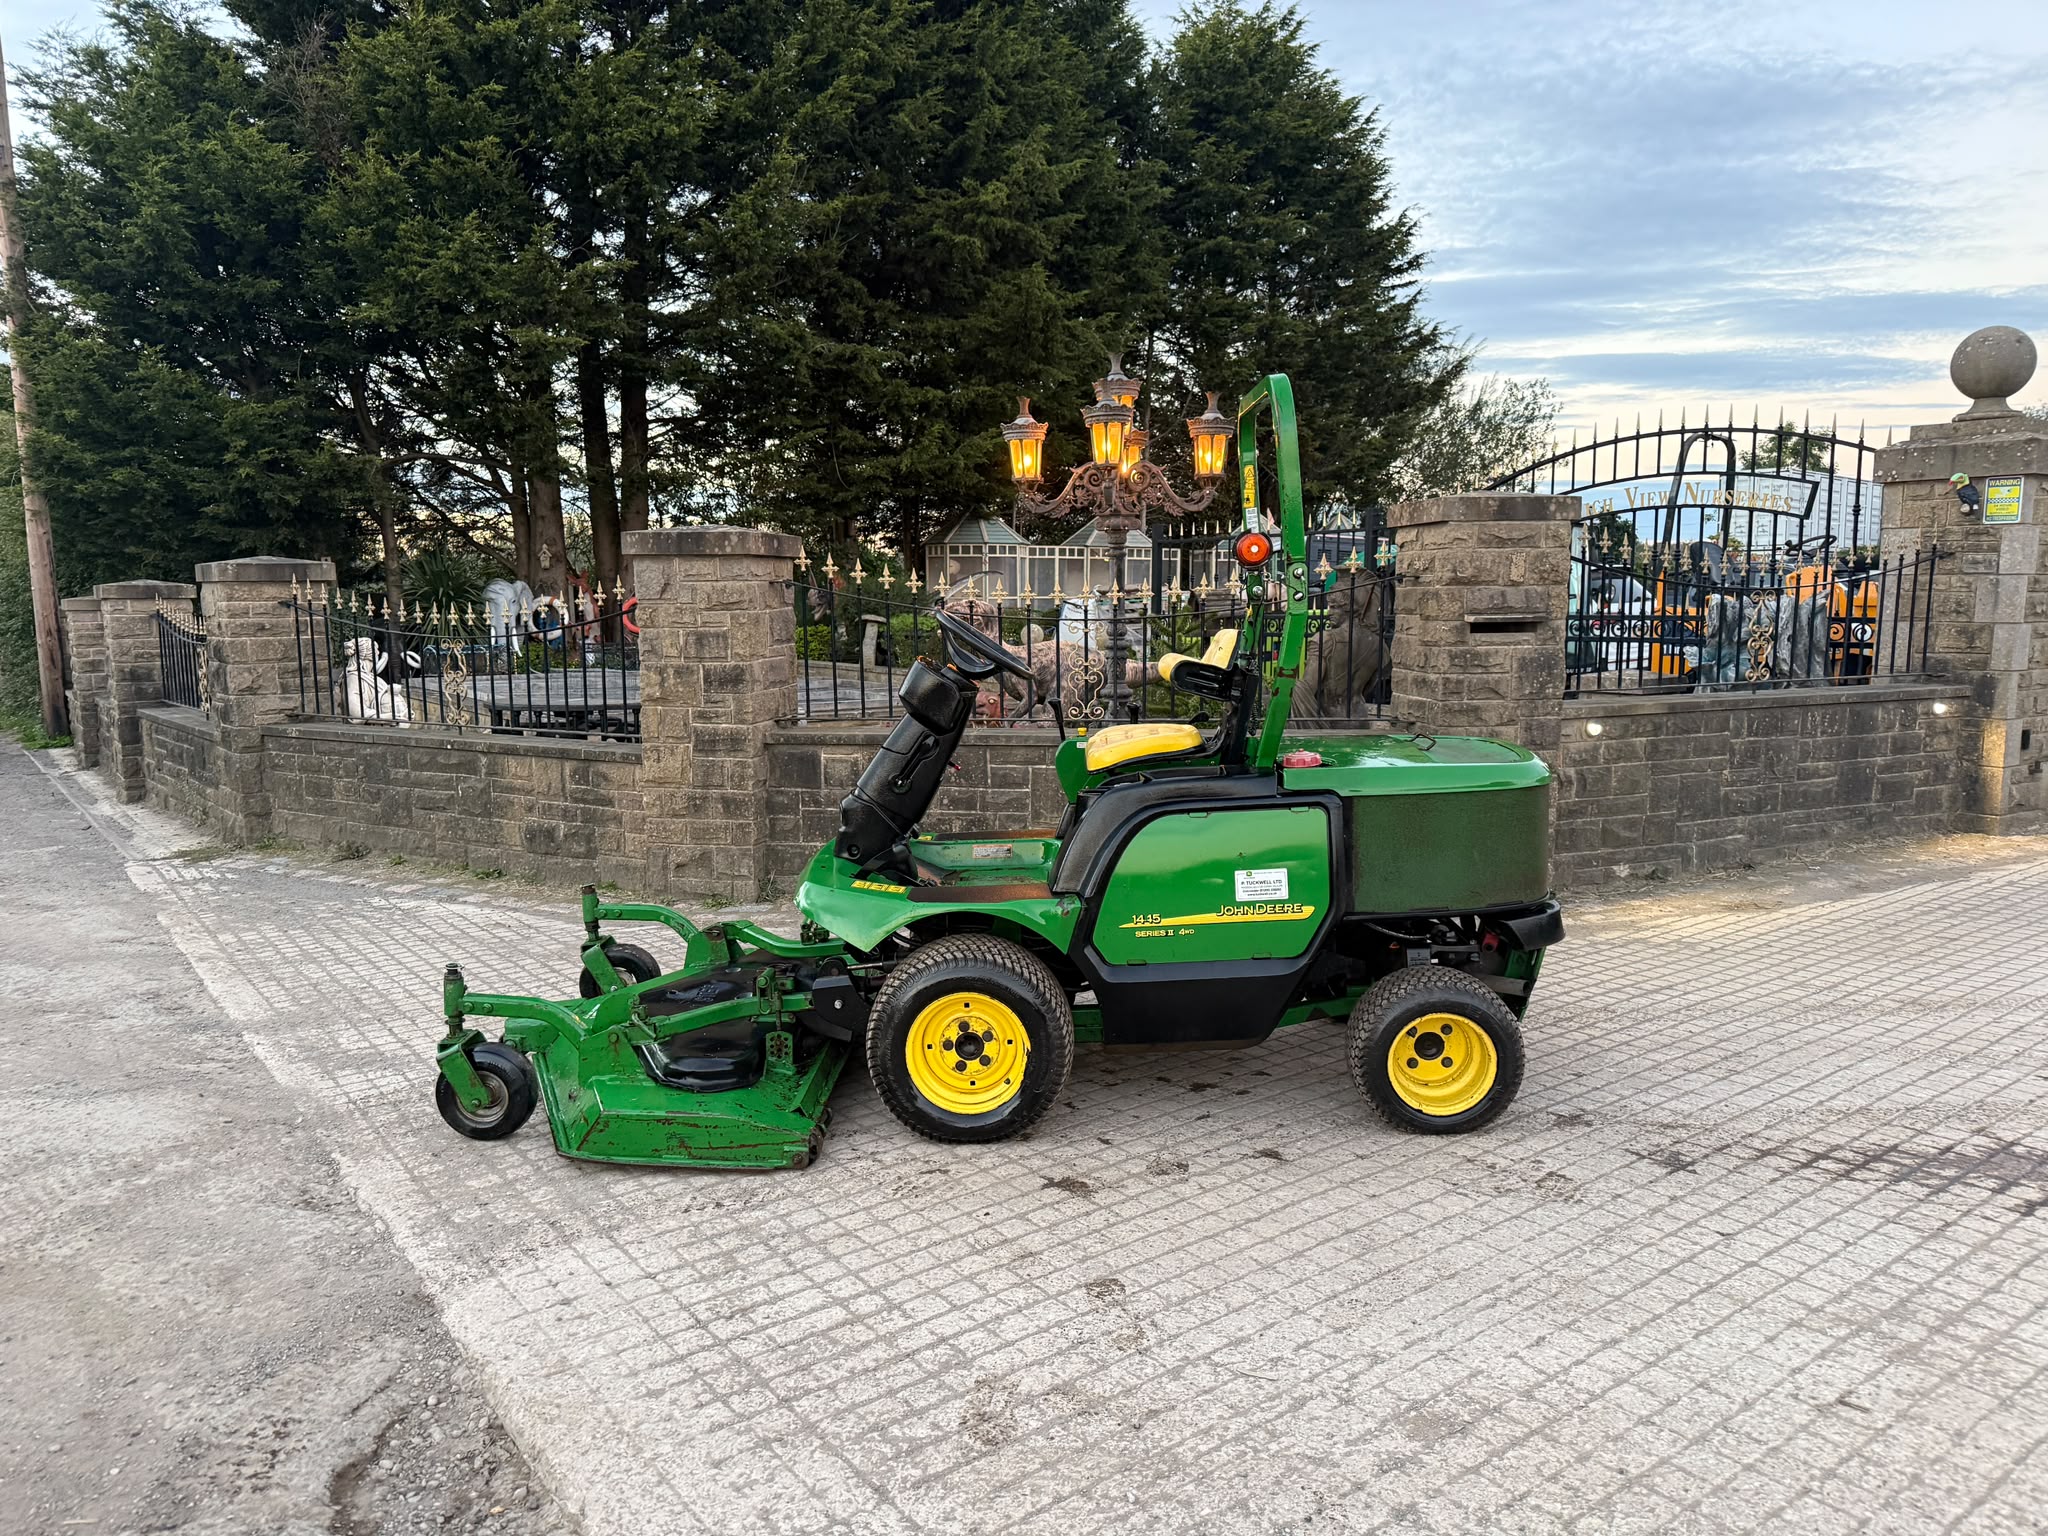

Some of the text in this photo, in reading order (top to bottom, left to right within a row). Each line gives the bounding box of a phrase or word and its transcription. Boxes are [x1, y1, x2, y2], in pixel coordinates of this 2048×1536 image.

[1624, 486, 1670, 508] VIEW
[1684, 482, 1793, 512] NURSERIES
[1217, 903, 1302, 916] JOHN DEERE
[1132, 914, 1161, 924] 1445
[1135, 930, 1166, 938] SERIES
